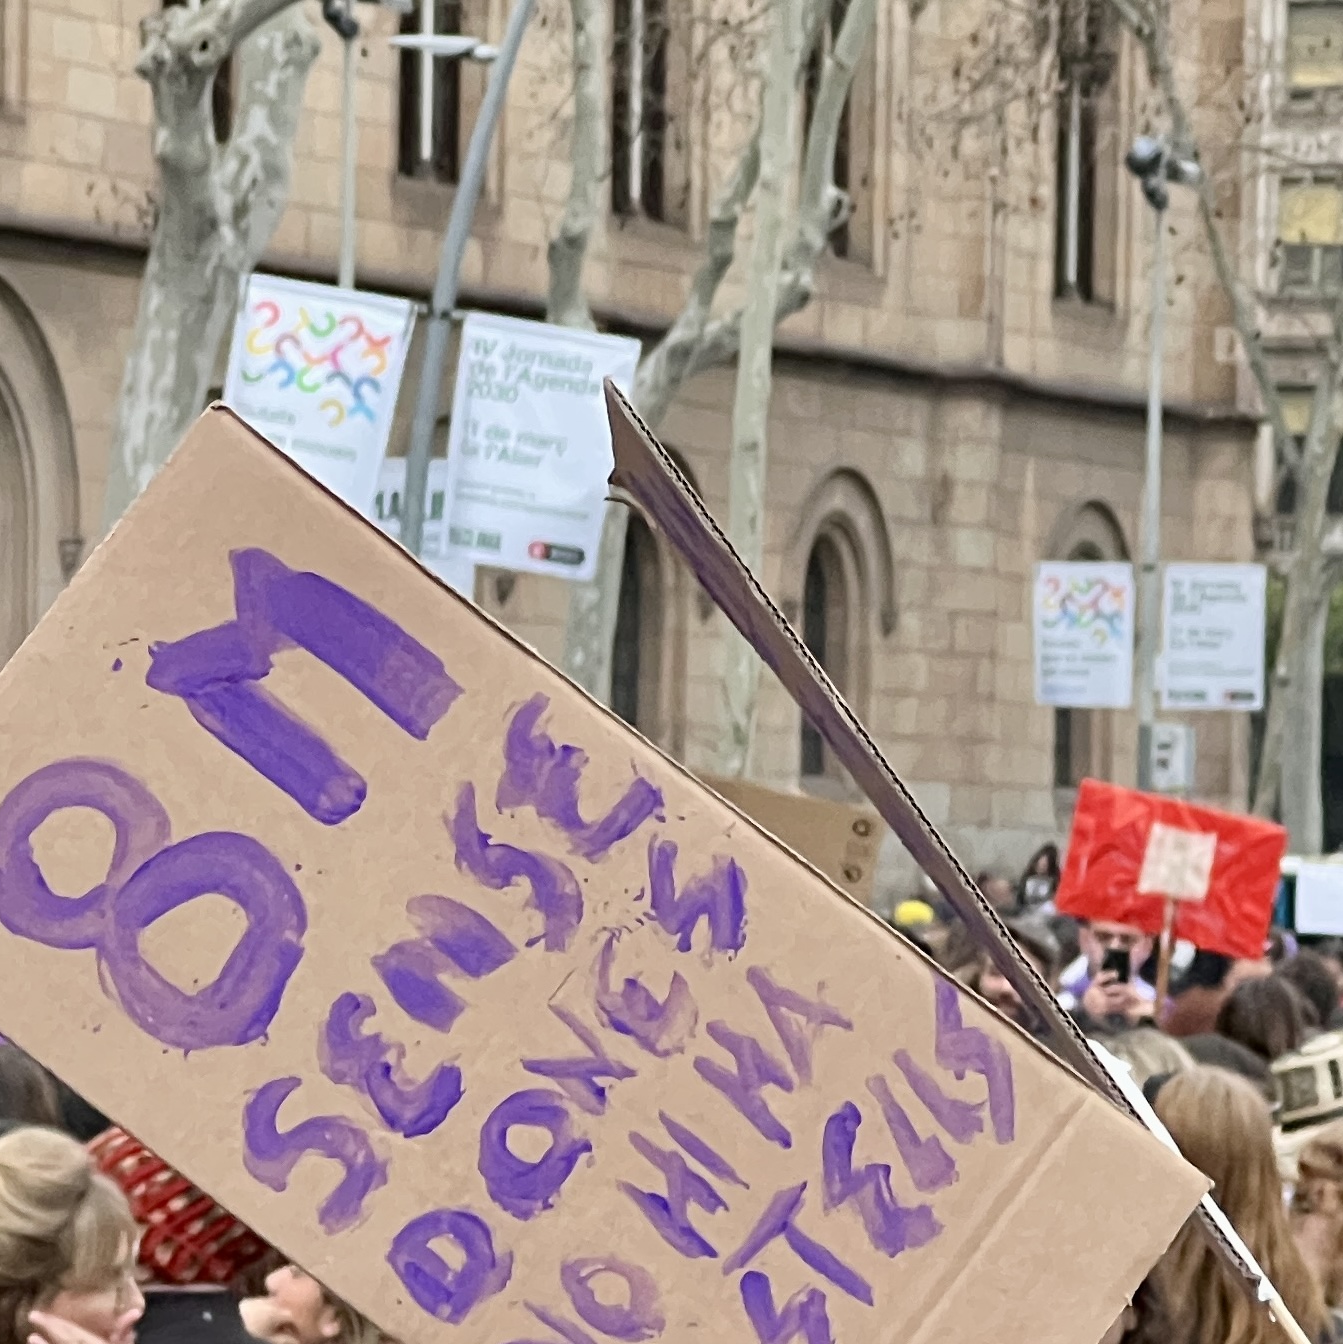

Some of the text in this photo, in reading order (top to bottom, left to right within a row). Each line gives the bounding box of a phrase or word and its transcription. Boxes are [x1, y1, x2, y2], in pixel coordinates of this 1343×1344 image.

[502, 340, 594, 373] Jornada
[242, 692, 666, 1233] SENSE
[386, 834, 748, 1325] DONES
[617, 1111, 749, 1260] HI
[693, 966, 853, 1148] HA
